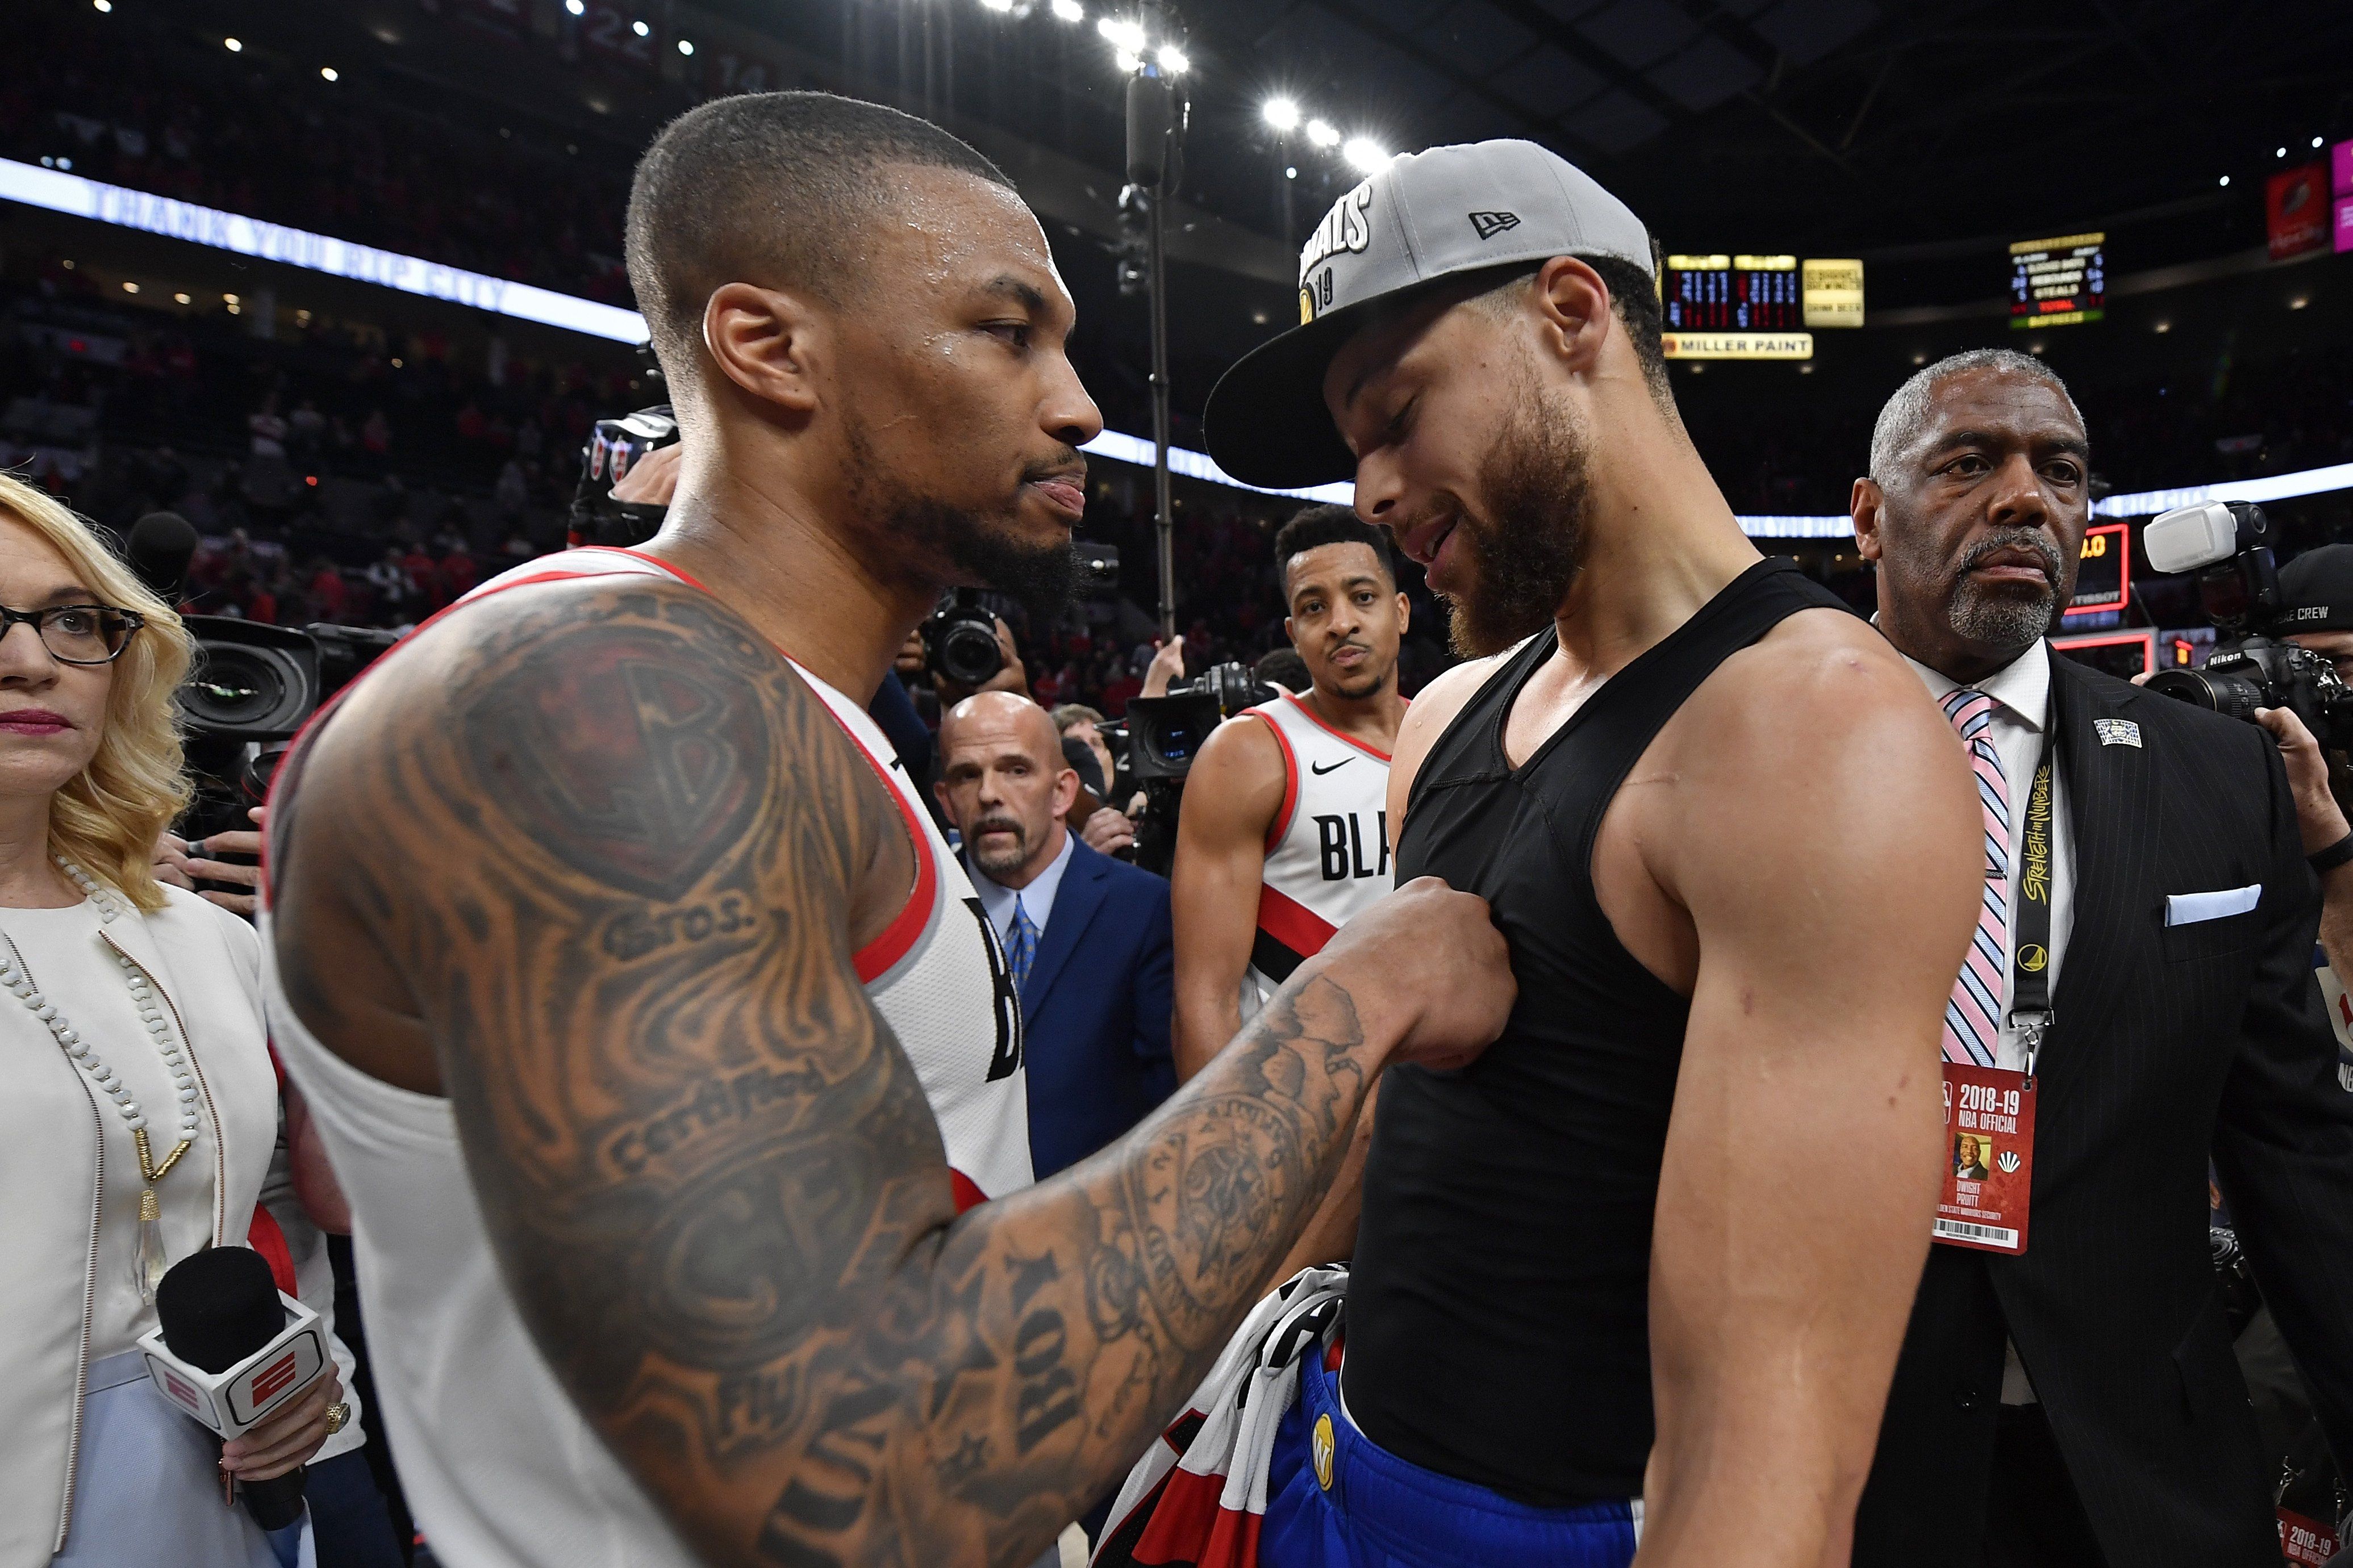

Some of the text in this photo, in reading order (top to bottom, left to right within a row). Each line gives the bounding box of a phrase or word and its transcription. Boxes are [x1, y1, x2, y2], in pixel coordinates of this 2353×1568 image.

[1299, 184, 1371, 290] NALS
[1681, 340, 1808, 352] MILLER PAINT
[2297, 606, 2329, 620] CREW
[2210, 651, 2241, 666] Nikon
[2027, 764, 2051, 822] NUMBERS
[2022, 830, 2050, 906] STRENGTH
[1959, 1083, 2020, 1115] 2018-19
[1958, 1109, 2018, 1134] NBA OFFICIAL
[1956, 1180, 1981, 1194] DWIGHT
[1006, 1251, 1079, 1454] BOY
[2287, 1542, 2301, 1557] NBA
[2289, 1526, 2331, 1556] 2018-19
